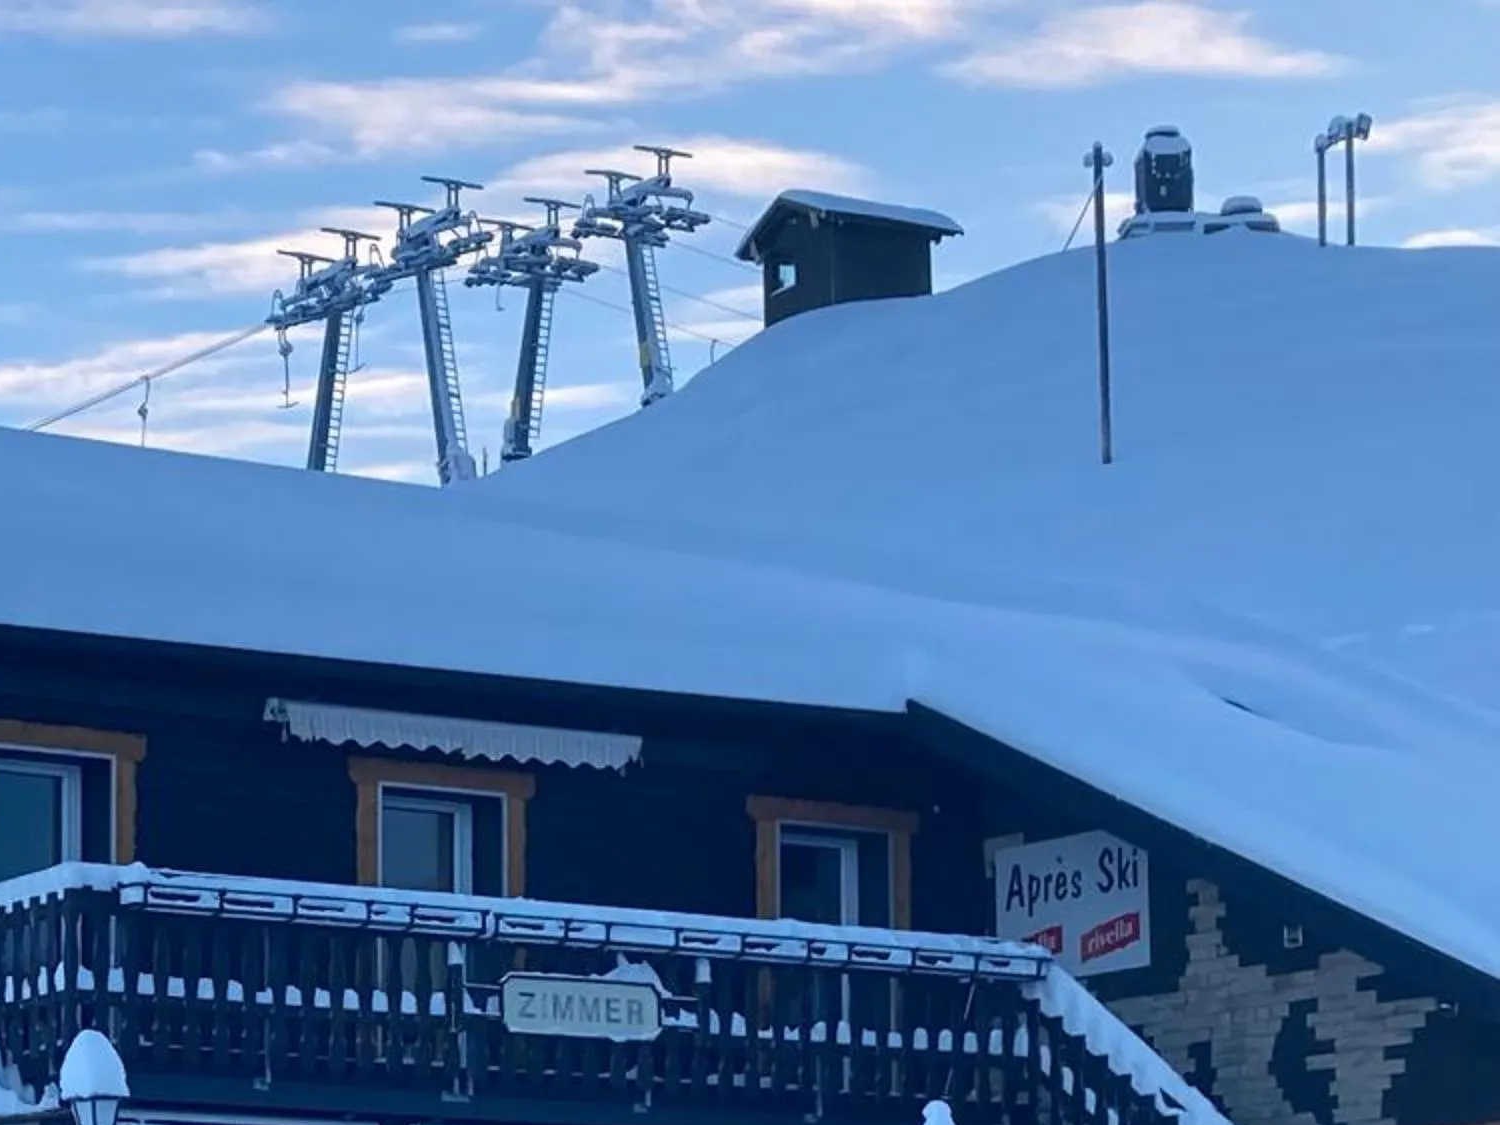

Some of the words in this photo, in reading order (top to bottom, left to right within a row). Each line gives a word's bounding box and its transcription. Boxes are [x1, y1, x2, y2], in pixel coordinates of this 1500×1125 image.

[1006, 856, 1083, 918] Après
[1097, 848, 1139, 893] Ski
[1087, 918, 1134, 954] rivella
[518, 991, 644, 1025] ZIMMER
